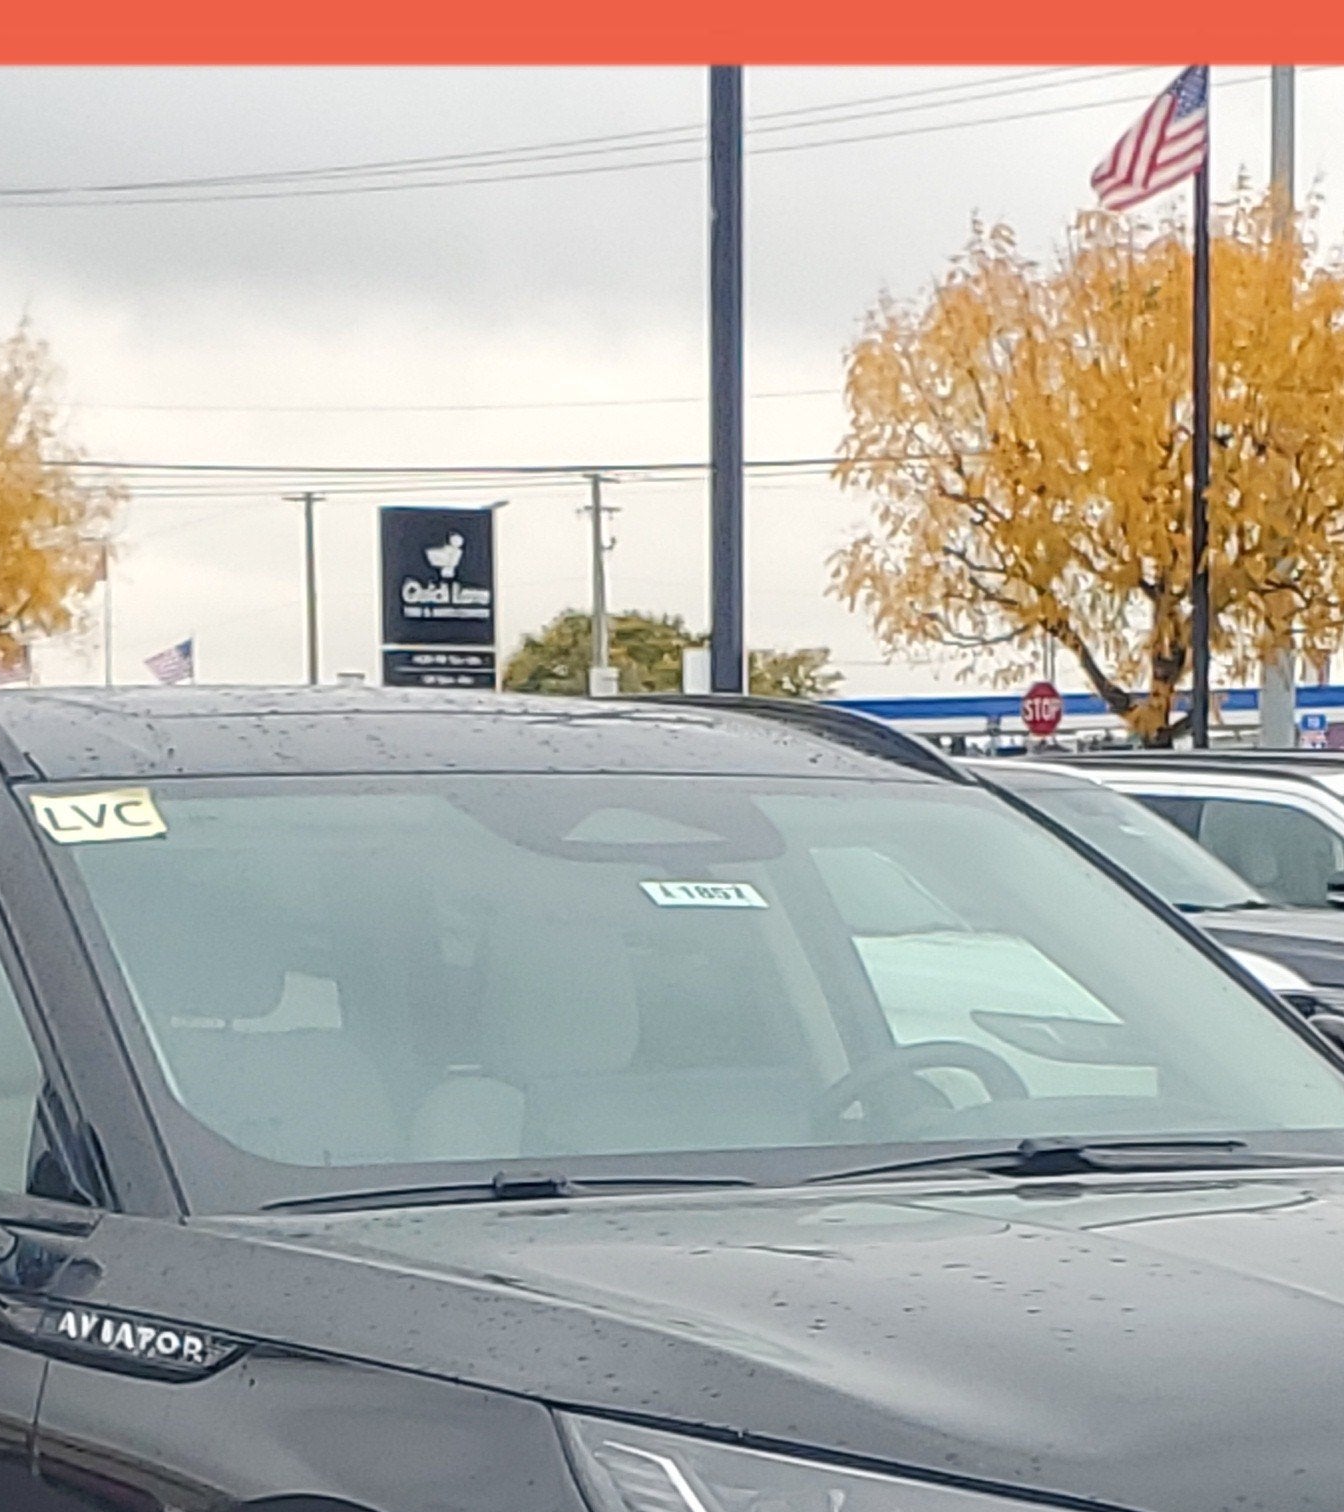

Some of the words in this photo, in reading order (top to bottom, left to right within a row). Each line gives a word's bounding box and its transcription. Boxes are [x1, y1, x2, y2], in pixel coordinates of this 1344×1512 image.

[1023, 697, 1060, 721] STOP
[43, 799, 153, 832] LVC
[58, 1310, 205, 1363] AVIATOR
